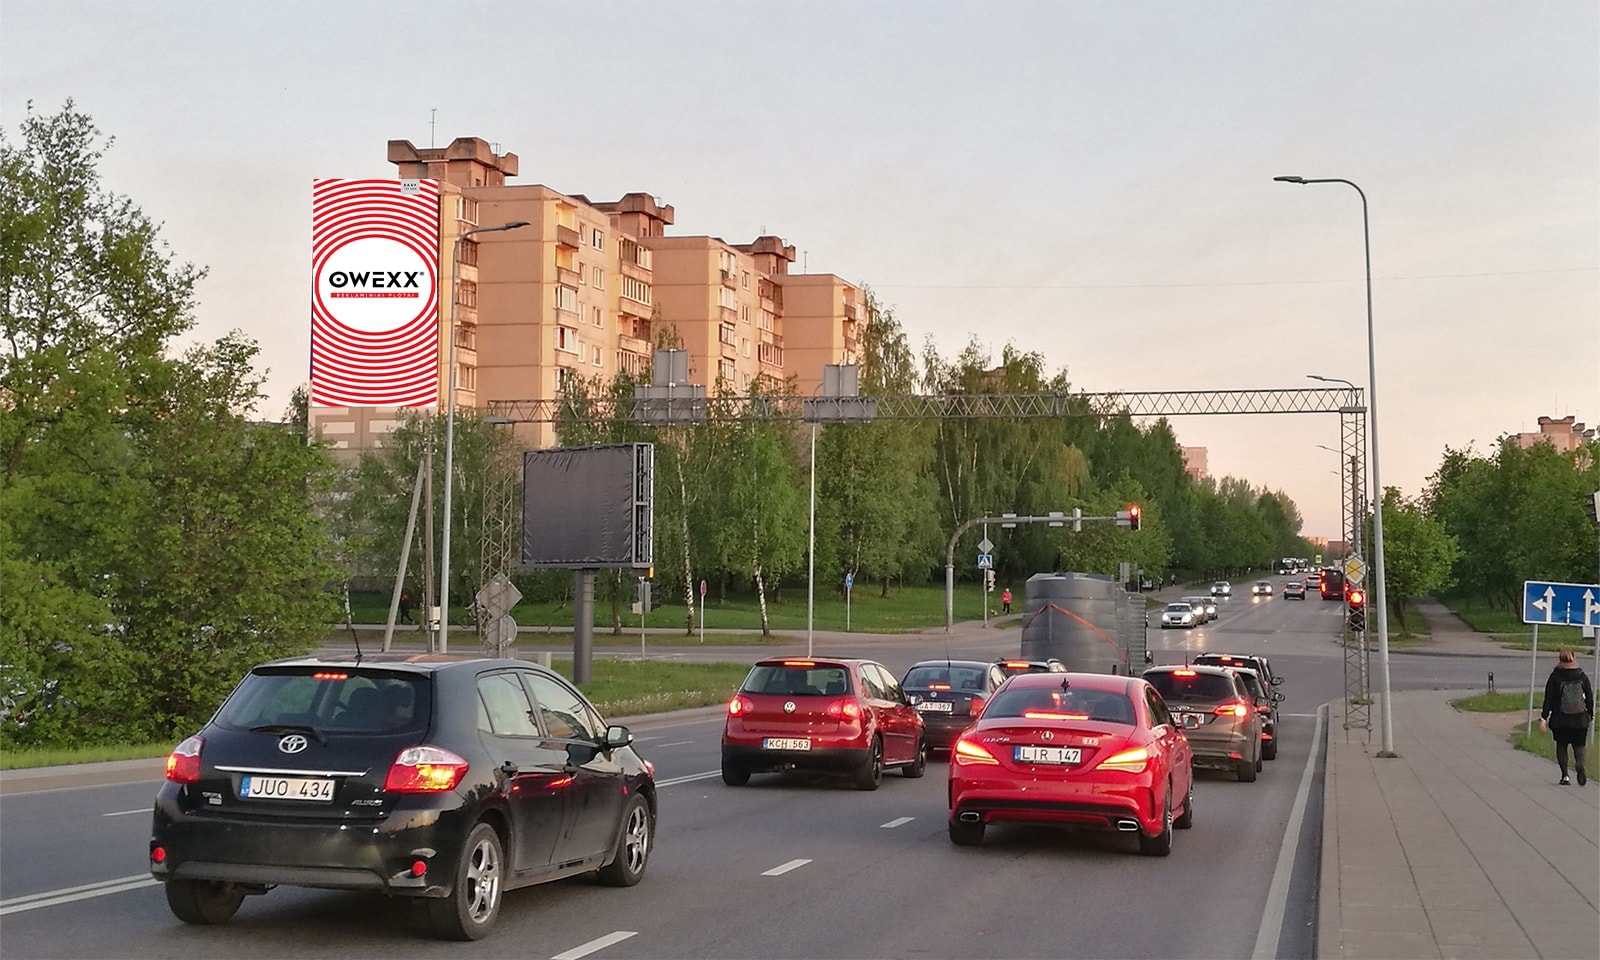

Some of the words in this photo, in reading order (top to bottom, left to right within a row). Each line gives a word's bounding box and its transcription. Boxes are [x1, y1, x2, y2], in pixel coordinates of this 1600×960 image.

[769, 740, 787, 748] KCH
[1022, 749, 1048, 760] LIR
[1058, 751, 1079, 761] 147
[252, 780, 288, 796] JUO
[299, 781, 330, 798] 434
